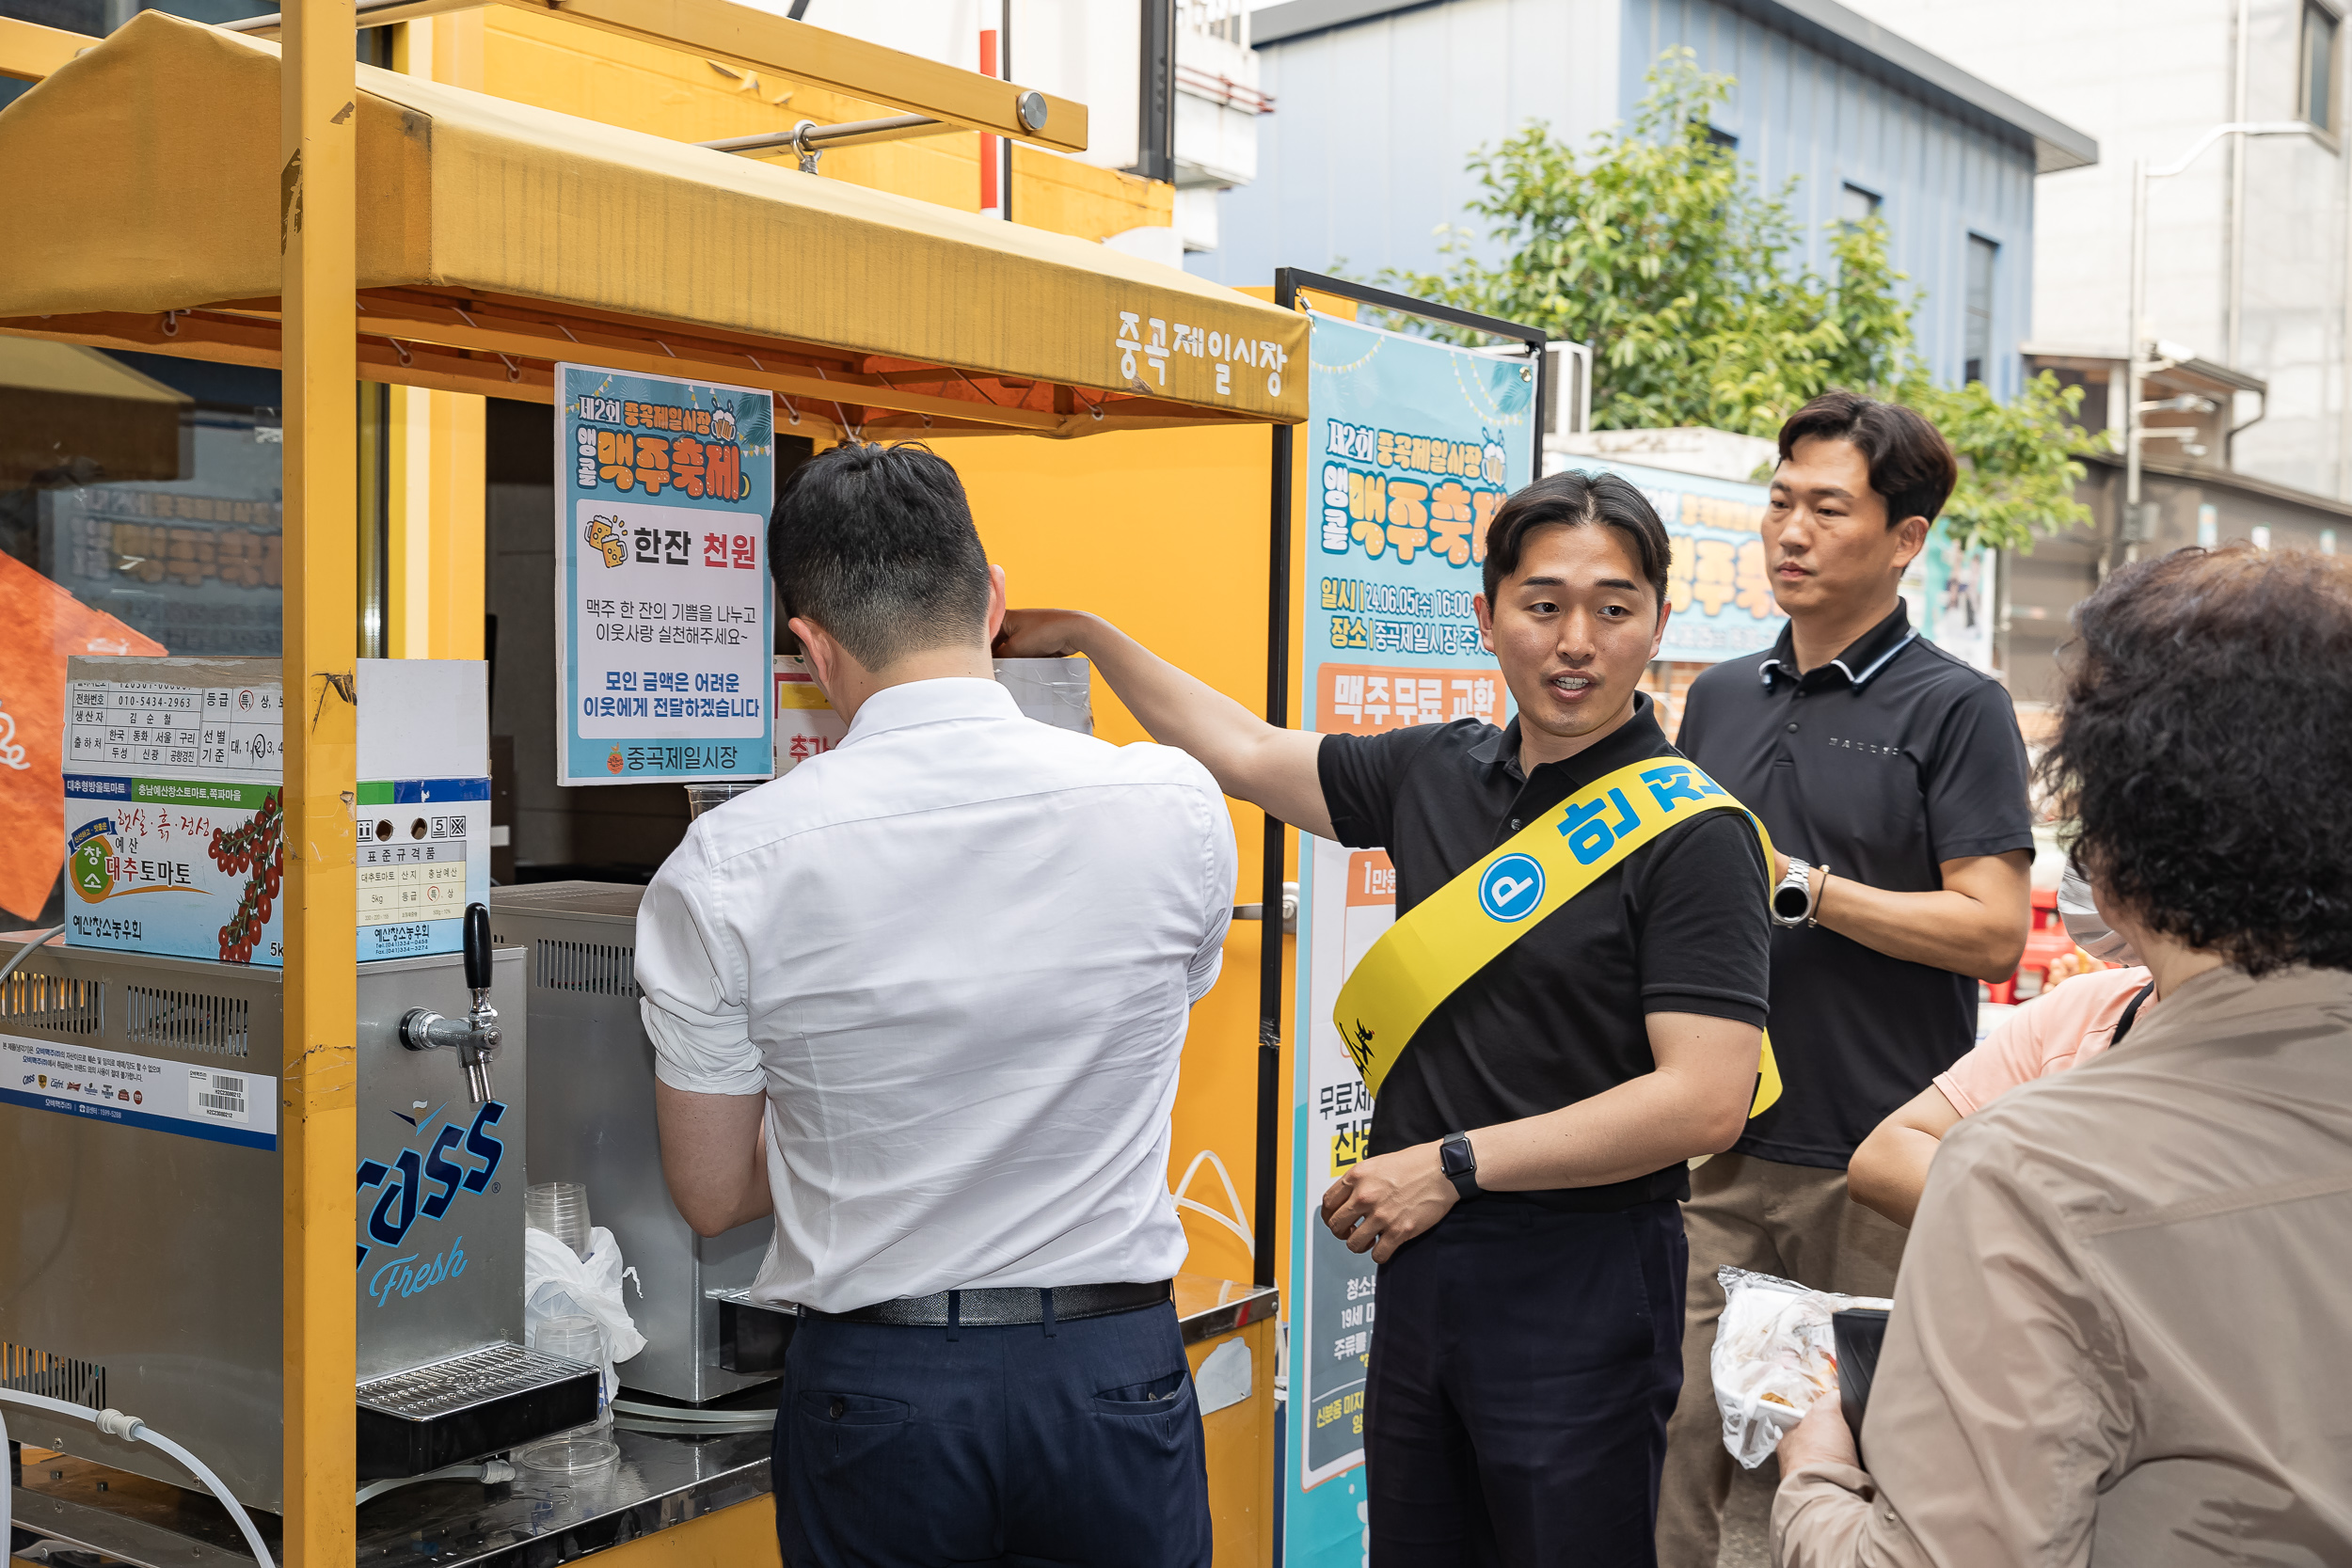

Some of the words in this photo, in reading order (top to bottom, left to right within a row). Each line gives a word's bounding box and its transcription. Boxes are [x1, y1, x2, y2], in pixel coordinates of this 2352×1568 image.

[1115, 310, 1288, 397] 중곡제일시장
[579, 395, 621, 424] 제2회
[624, 401, 711, 436] 중곡제일시장
[1327, 419, 1374, 462] 제2회
[1377, 430, 1483, 479] 중곡제일시장
[597, 431, 740, 501] 맥주축제
[633, 527, 691, 565] 한잔
[704, 532, 755, 570] 천원
[1321, 578, 1356, 610] 일시
[1366, 584, 1434, 616] 24.06.05(수)
[1437, 591, 1474, 617] 16:00
[586, 599, 615, 619] 맥주
[620, 600, 634, 620] 한
[638, 602, 667, 621] 잔의
[672, 603, 713, 623] 기쁨을
[717, 606, 756, 625] 나누고
[596, 623, 654, 643] 이웃사랑
[659, 626, 748, 645] 실천해주세요~
[1331, 617, 1367, 648] 장소
[1375, 621, 1457, 654] 중곡제일시장
[606, 671, 637, 691] 모인
[643, 672, 690, 692] 금액은
[694, 673, 739, 693] 어려운
[75, 693, 104, 705] 전화번호
[118, 696, 191, 708] 010-5434-2963
[206, 692, 229, 707] 등급
[583, 696, 648, 718] 이웃에게
[653, 697, 760, 718] 전달하겠습니다
[1450, 677, 1496, 724] 교환
[75, 711, 103, 723] 생산자
[74, 736, 102, 749] 출하처
[109, 729, 125, 741] 한국
[133, 730, 148, 742] 동화
[155, 732, 172, 744] 서울
[179, 733, 195, 745] 구리
[203, 729, 226, 745] 선별
[111, 748, 128, 759] 두성
[142, 749, 159, 761] 신광
[202, 748, 225, 763] 기준
[627, 745, 738, 770] 중곡제일시장
[789, 733, 844, 763] 추가
[67, 780, 125, 794] 대추형방울토마토
[115, 837, 138, 854] 예산
[105, 857, 192, 886] 대추토마토
[361, 871, 395, 883] 대추토마토
[371, 895, 384, 905] 5kg
[1493, 876, 1535, 908] P
[72, 914, 141, 941] 예산창소농우회
[373, 924, 430, 942] 예산창소농우회
[369, 1235, 468, 1307] Fresh
[1341, 1305, 1364, 1329] 19세
